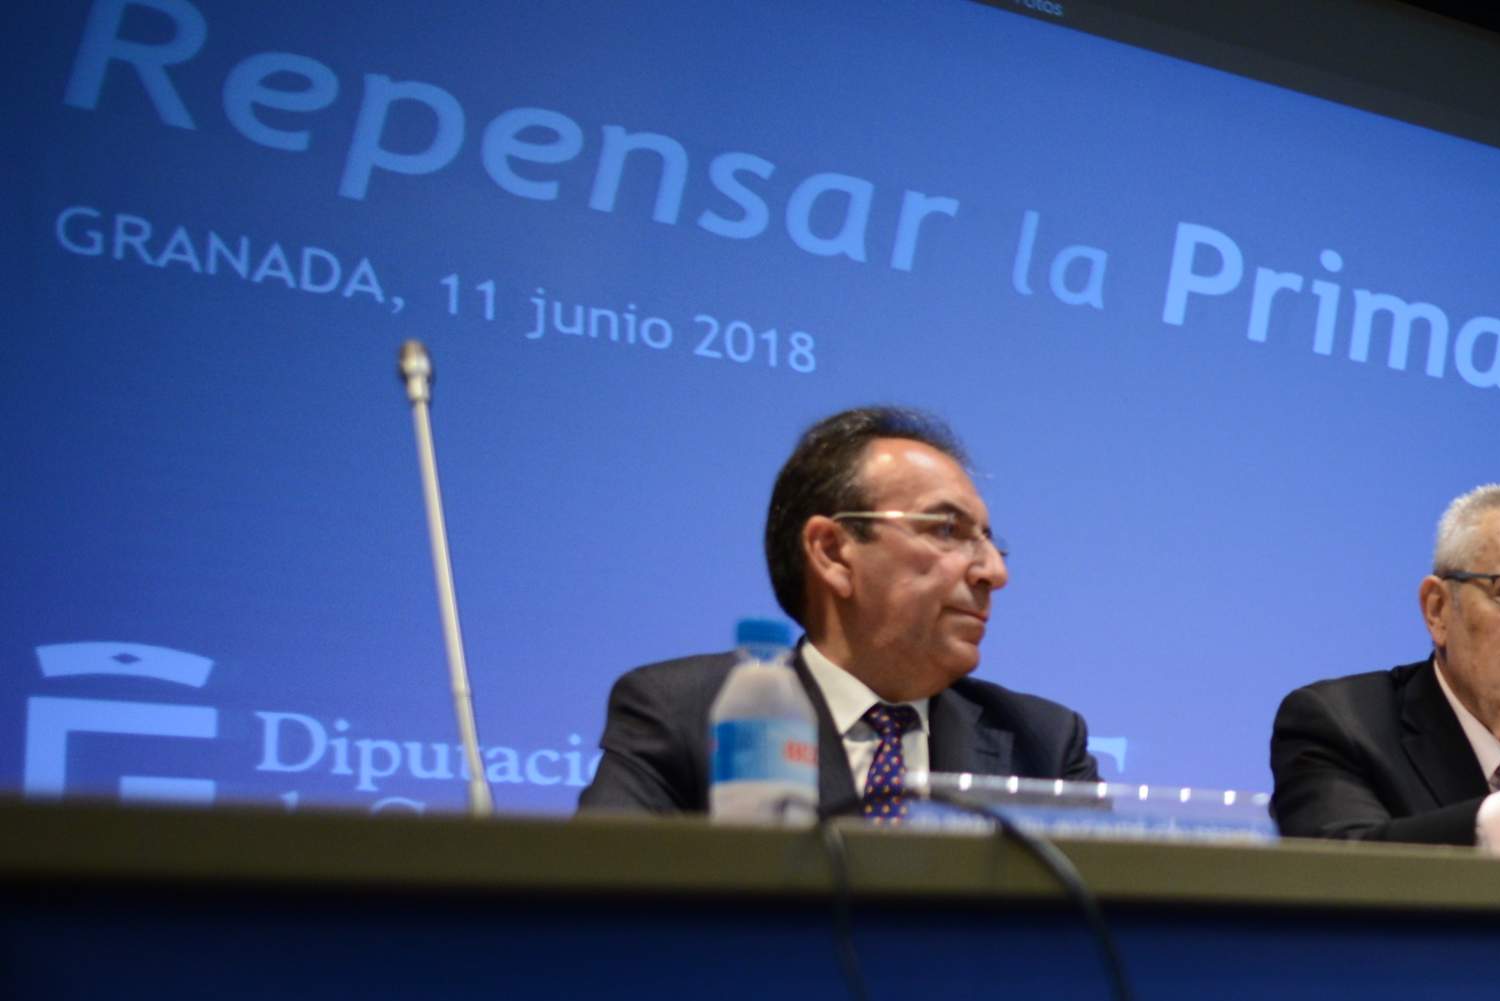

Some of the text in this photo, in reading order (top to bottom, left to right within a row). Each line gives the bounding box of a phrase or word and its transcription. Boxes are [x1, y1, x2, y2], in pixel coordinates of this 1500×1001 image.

[64, 0, 960, 272] Repensar
[1012, 209, 1108, 311] la
[55, 205, 817, 374] GRANADA, 11 junio 2018
